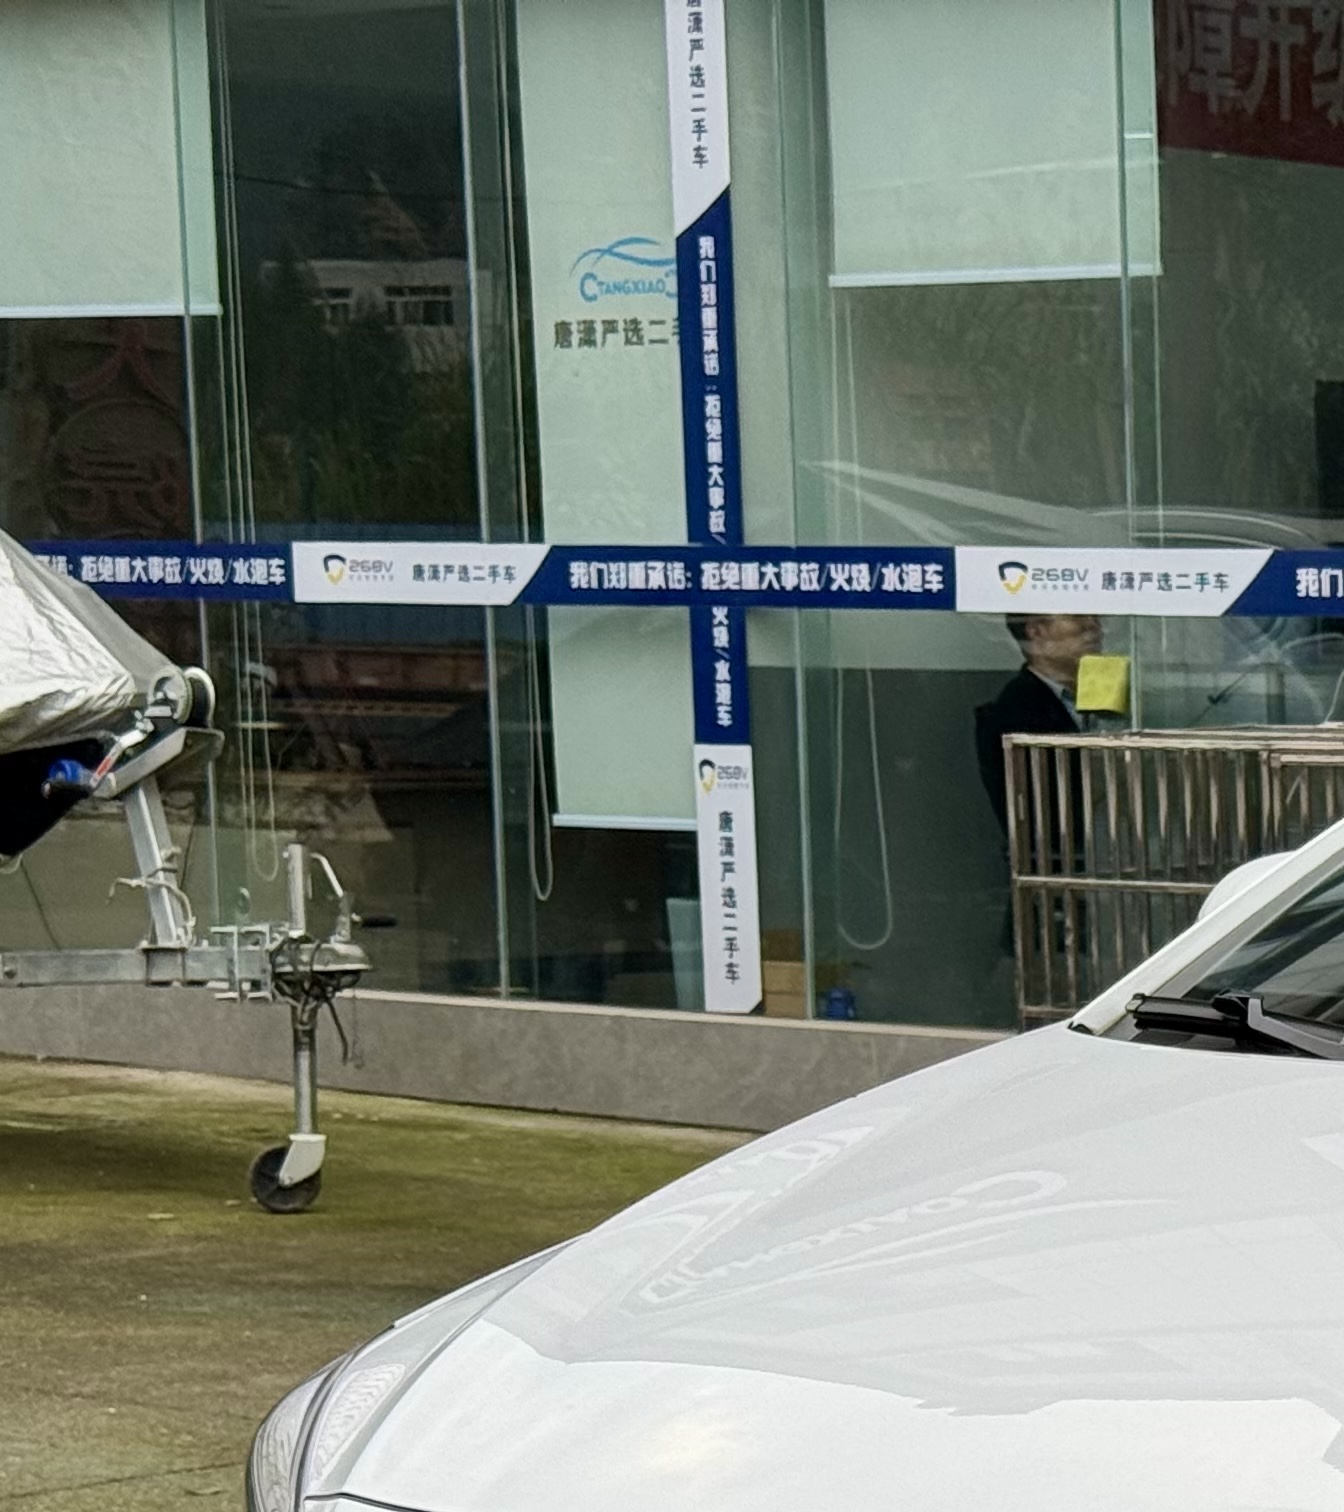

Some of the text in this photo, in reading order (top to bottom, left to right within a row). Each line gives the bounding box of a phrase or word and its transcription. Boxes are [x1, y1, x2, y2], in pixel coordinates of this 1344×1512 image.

[412, 563, 518, 584] 唐潇严选二手车
[1031, 568, 1090, 582] 268V
[1101, 571, 1230, 593] 唐潇严选二手车
[718, 810, 741, 986] 唐潇严选二手车
